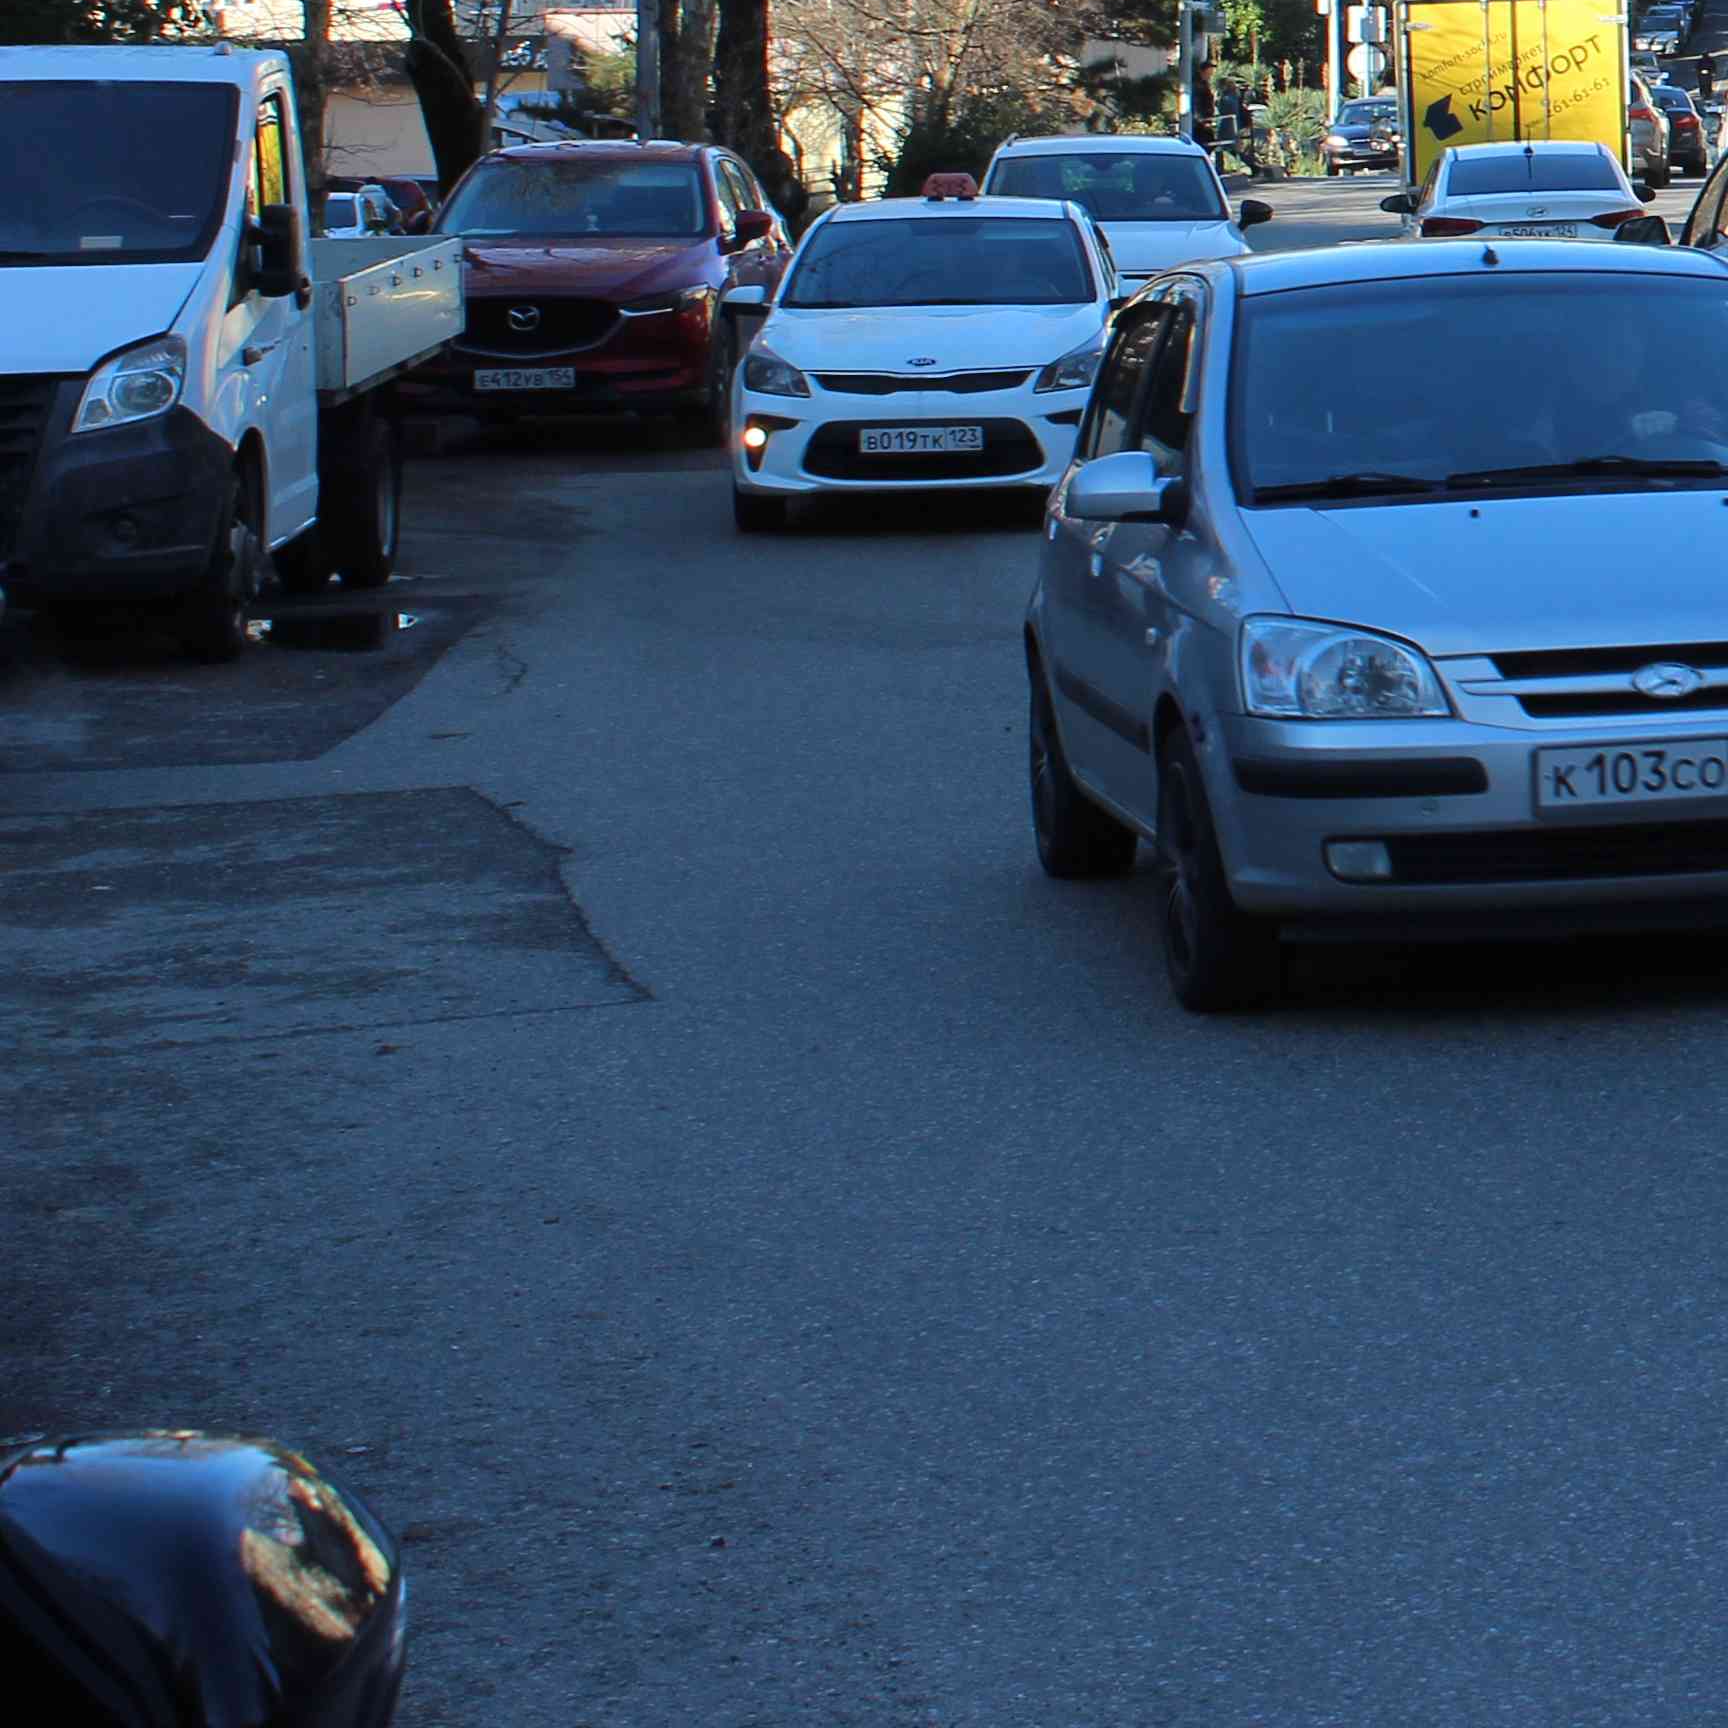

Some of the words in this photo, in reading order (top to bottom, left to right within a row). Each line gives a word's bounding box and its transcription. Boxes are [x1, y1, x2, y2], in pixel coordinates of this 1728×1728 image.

[867, 432, 944, 450] В019ТК
[948, 428, 977, 443] 123
[1553, 749, 1726, 798] К103СО
